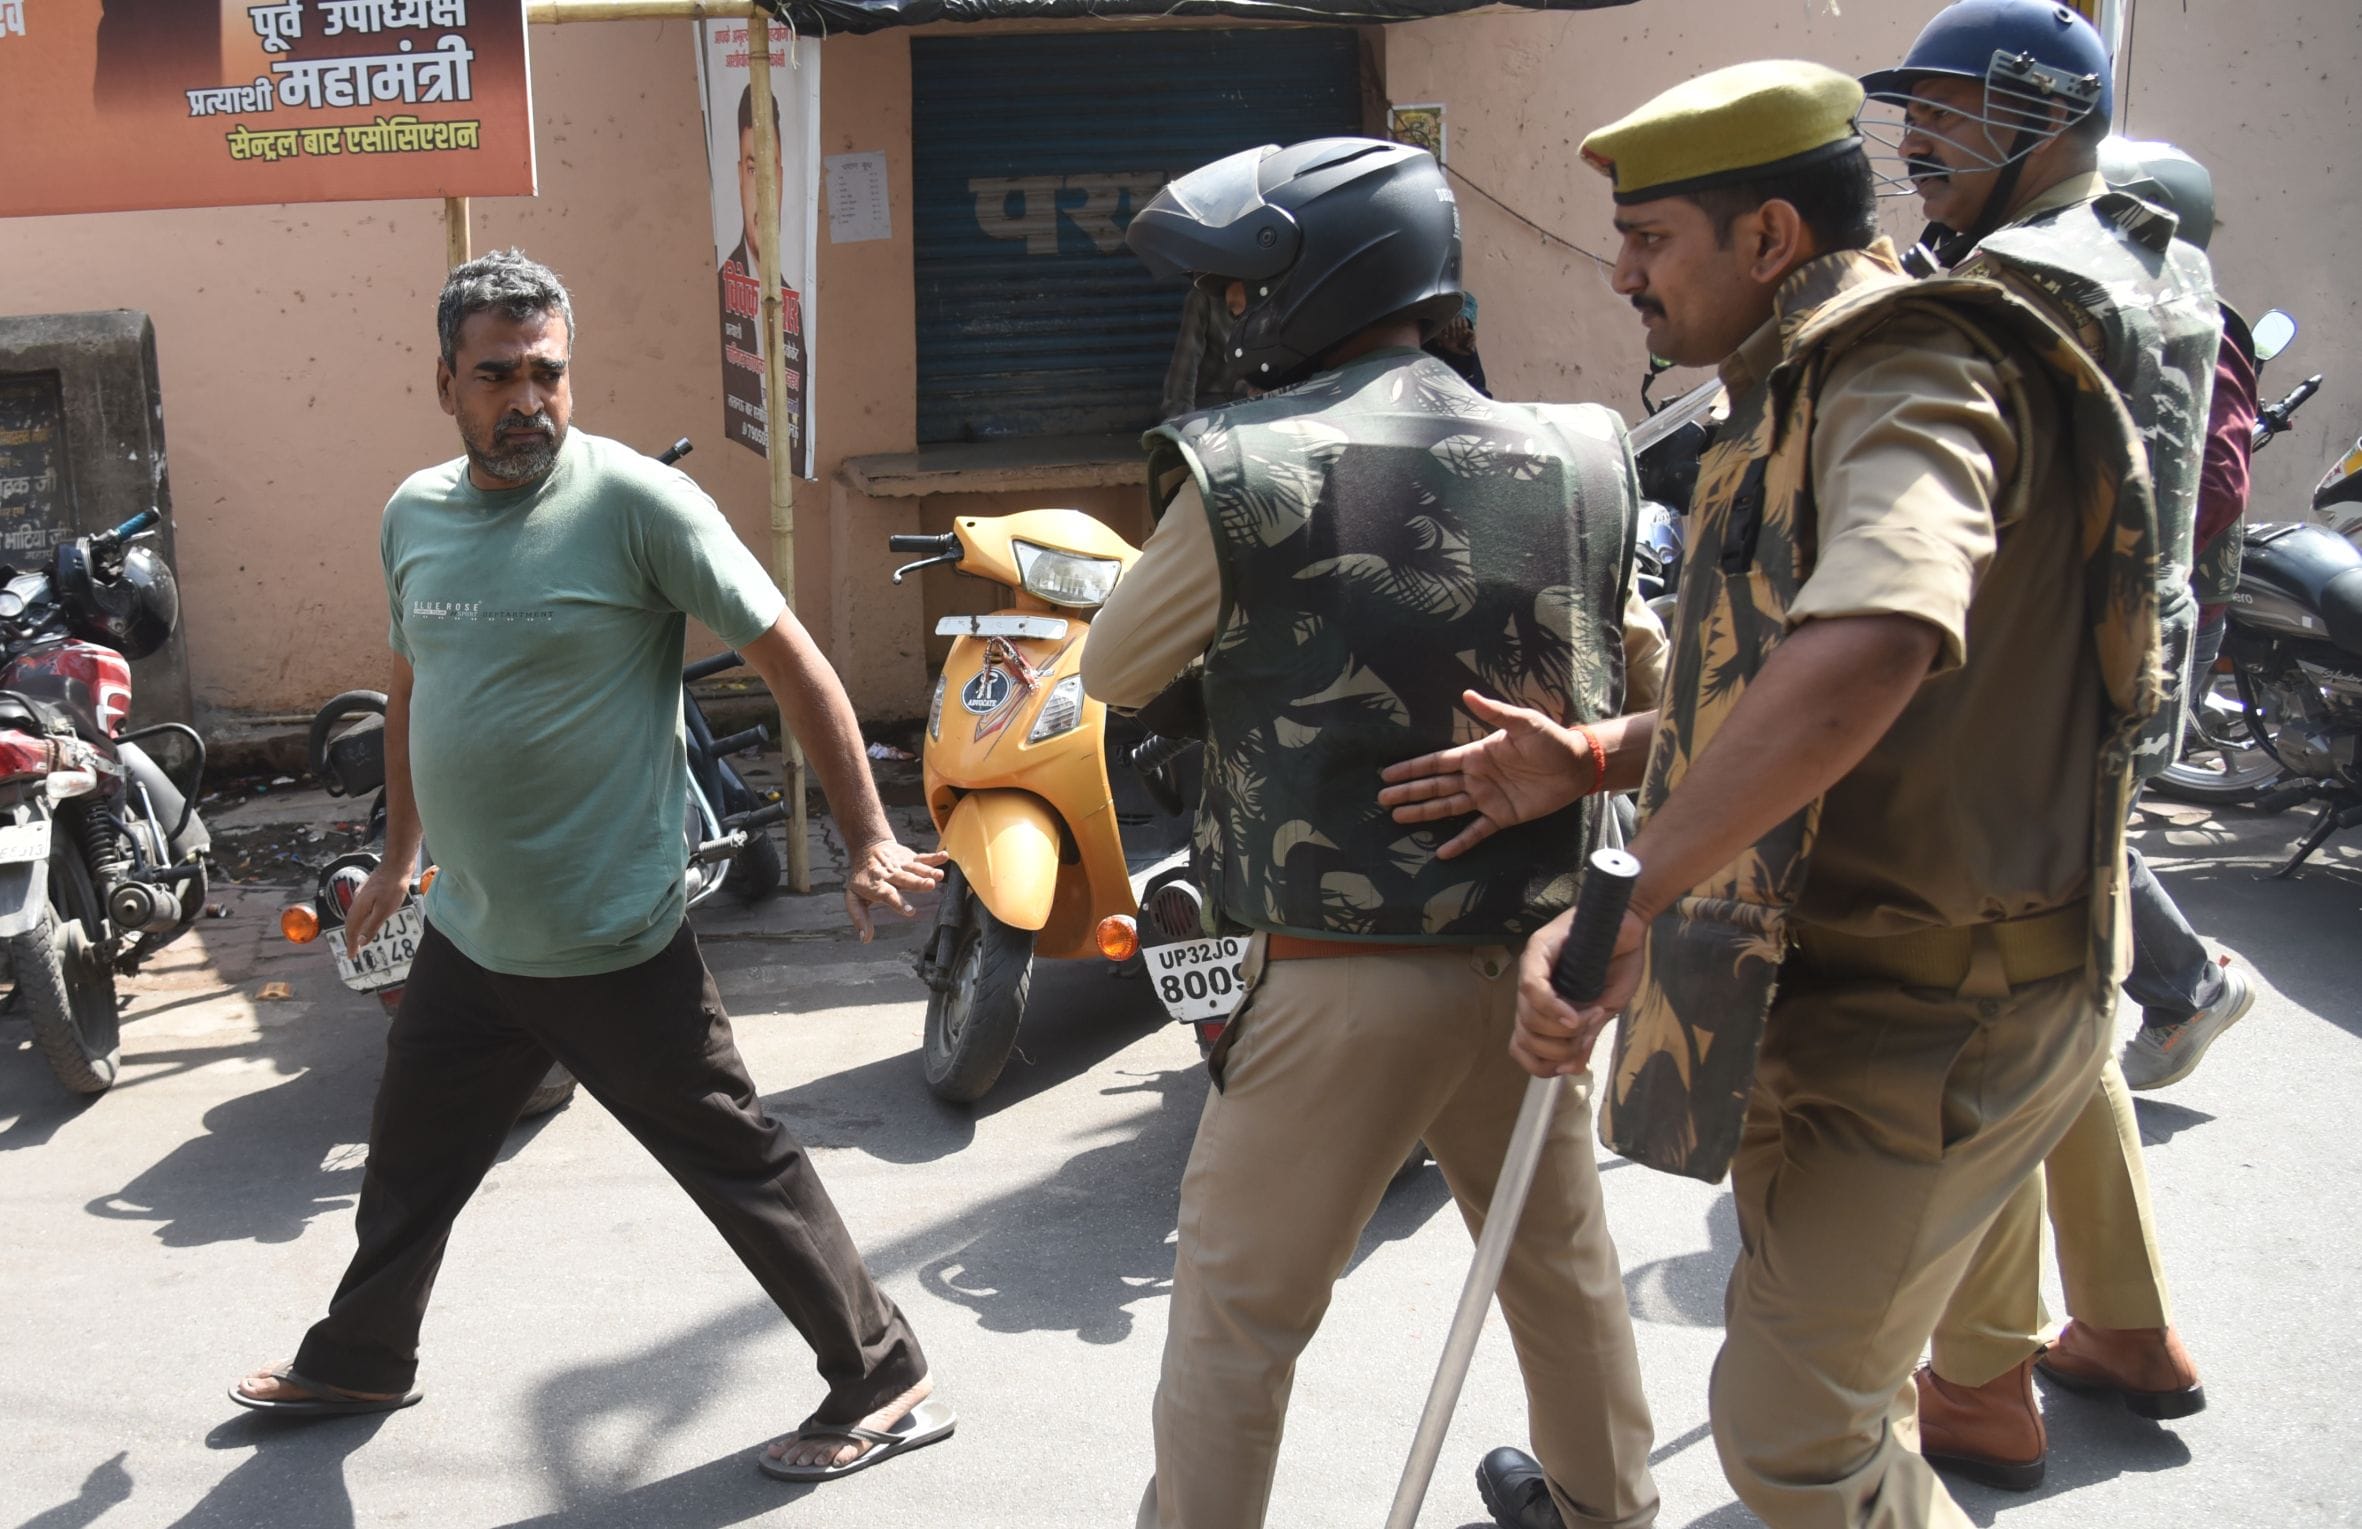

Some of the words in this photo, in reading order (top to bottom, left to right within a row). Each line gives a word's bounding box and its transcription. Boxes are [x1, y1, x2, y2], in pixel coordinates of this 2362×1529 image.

[186, 77, 275, 116] प्रत्याशी
[272, 35, 475, 110] महामंत्री
[226, 124, 300, 162] सेन्ट्रल
[301, 127, 342, 156] बार
[344, 115, 480, 152] एसोसिएशन
[414, 600, 441, 610] BLUE
[446, 602, 479, 612] ROSE
